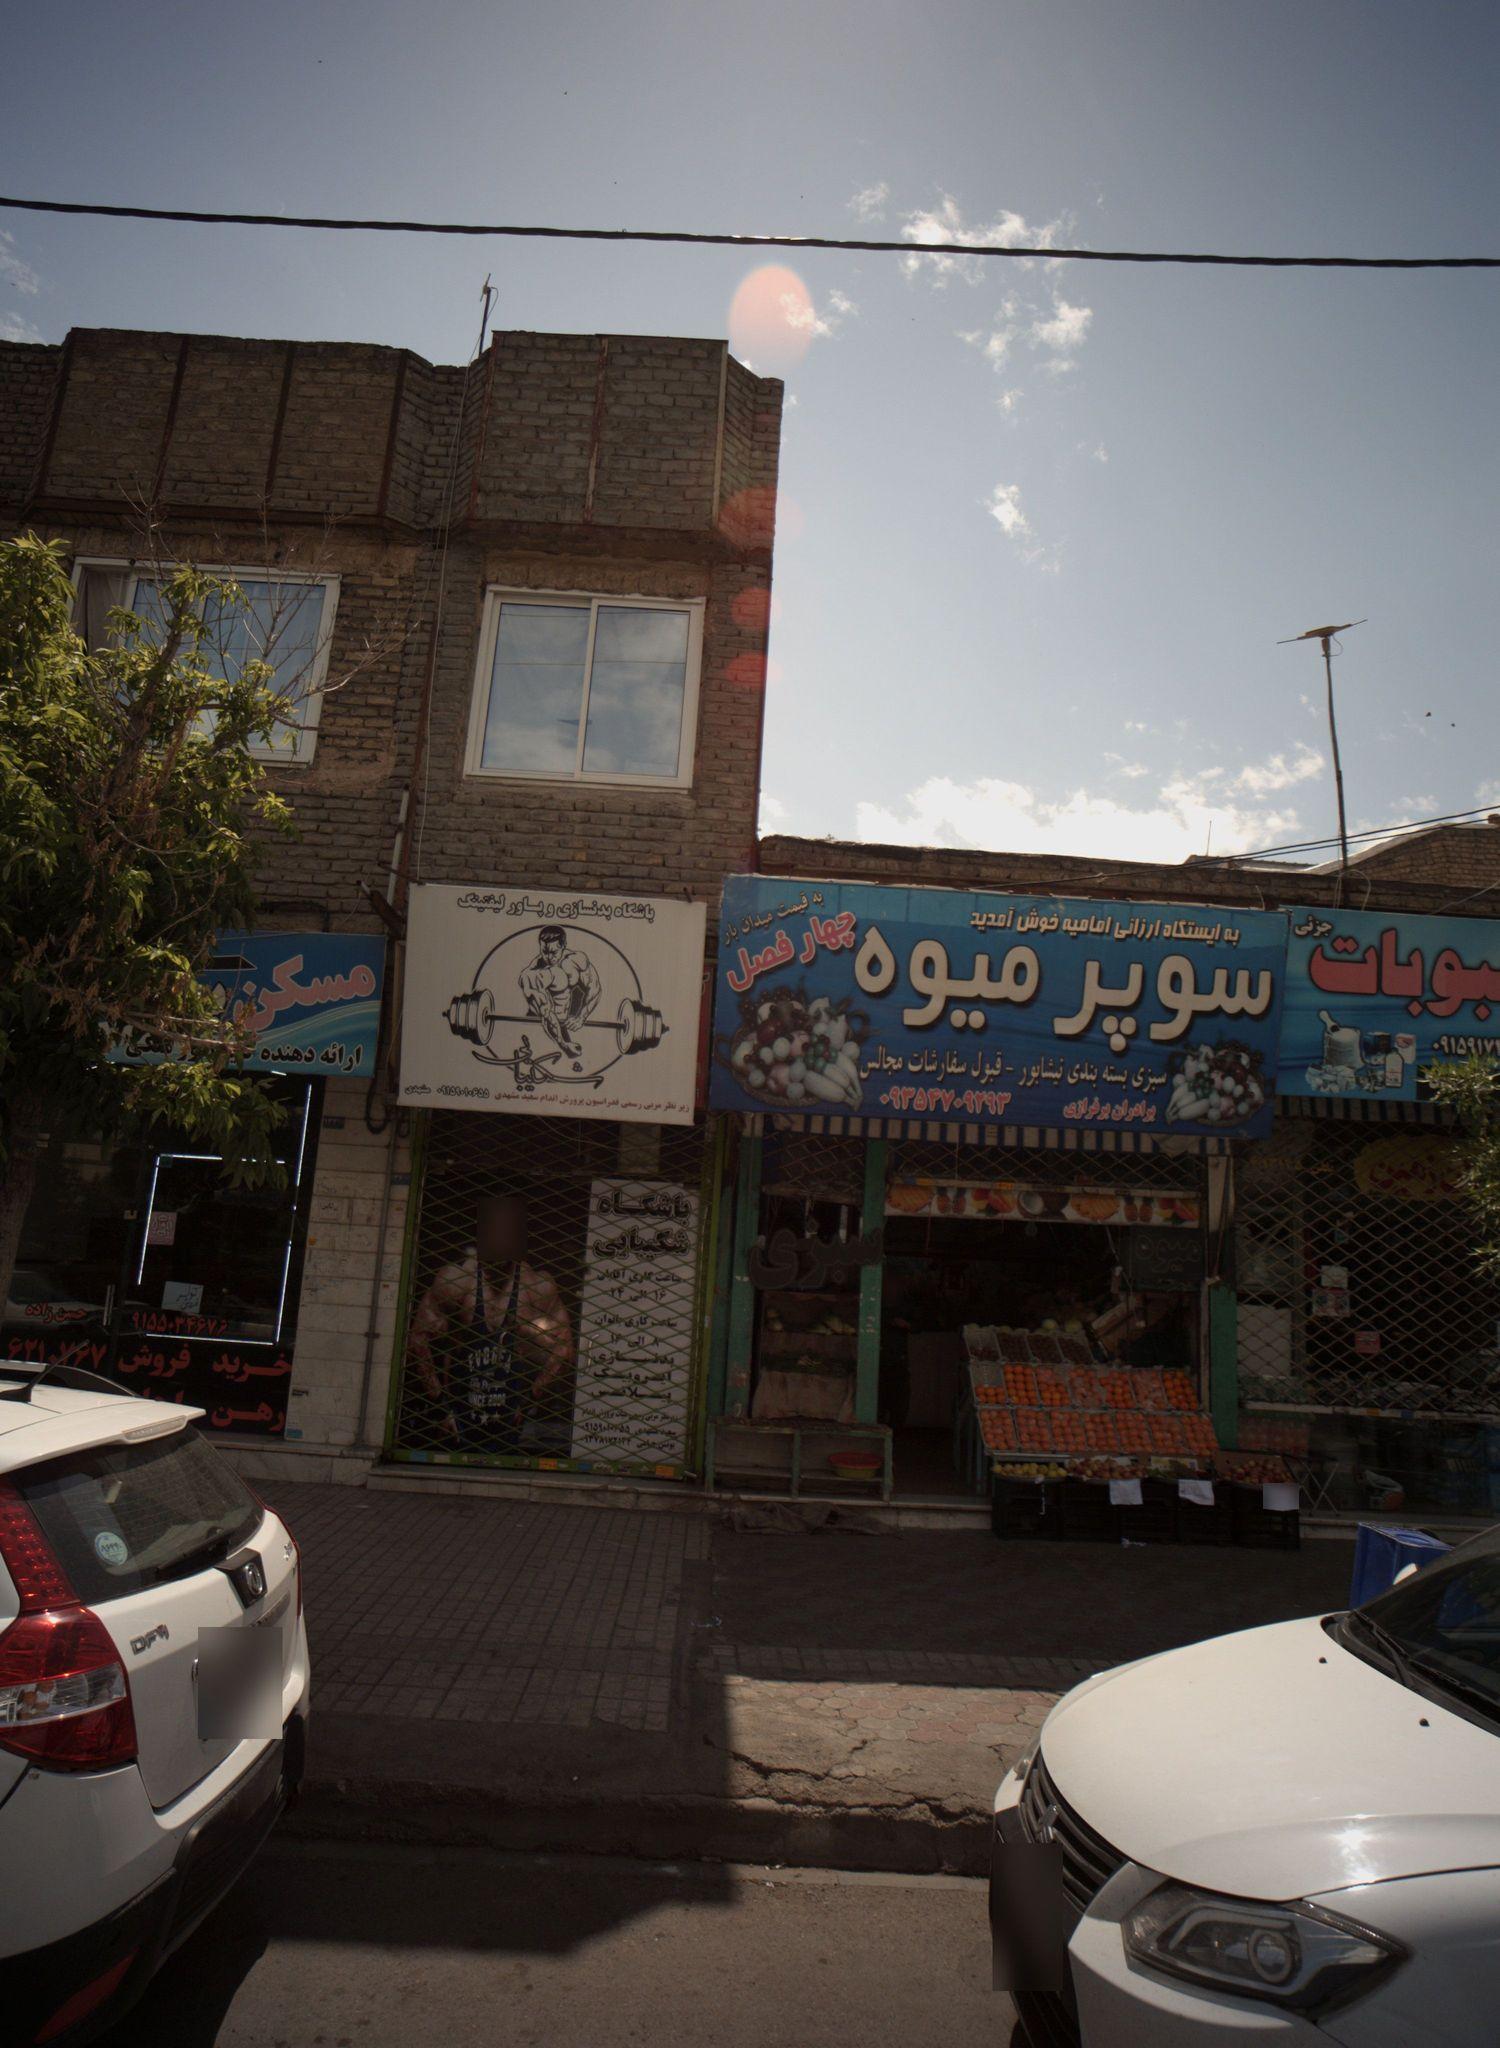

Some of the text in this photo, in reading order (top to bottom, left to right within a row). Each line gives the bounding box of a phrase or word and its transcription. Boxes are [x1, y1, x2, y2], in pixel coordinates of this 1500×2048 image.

[507, 896, 545, 918] پاور
[545, 903, 555, 917] و
[556, 900, 612, 920] بدنسازی
[614, 902, 655, 924] باشگاه
[777, 892, 809, 918] قیمت
[812, 890, 825, 908] به
[742, 912, 773, 934] میدان
[799, 911, 857, 964] چهار
[970, 906, 1241, 946] به ایستگاه ارزانی امامیه خوش آمدید
[727, 929, 795, 992] فصل
[1308, 927, 1500, 1021] بوبات
[232, 953, 377, 1033] مسکن
[854, 925, 1273, 1053] سوپر میوه
[261, 1044, 317, 1064] دهنده
[320, 1041, 363, 1072] ارائه
[859, 1045, 904, 1079] مجالس
[908, 1048, 967, 1082] سفارشات
[971, 1050, 1003, 1083] قبول
[1018, 1056, 1064, 1086] نیشابور
[1067, 1060, 1098, 1089] بندی
[1102, 1067, 1128, 1091] بسته
[1131, 1064, 1168, 1092] سبزی
[1111, 1098, 1157, 1122] برادران
[597, 1191, 691, 1227] باشگاه
[116, 1342, 292, 1382] خرید فروش
[210, 1400, 286, 1432] رهن
